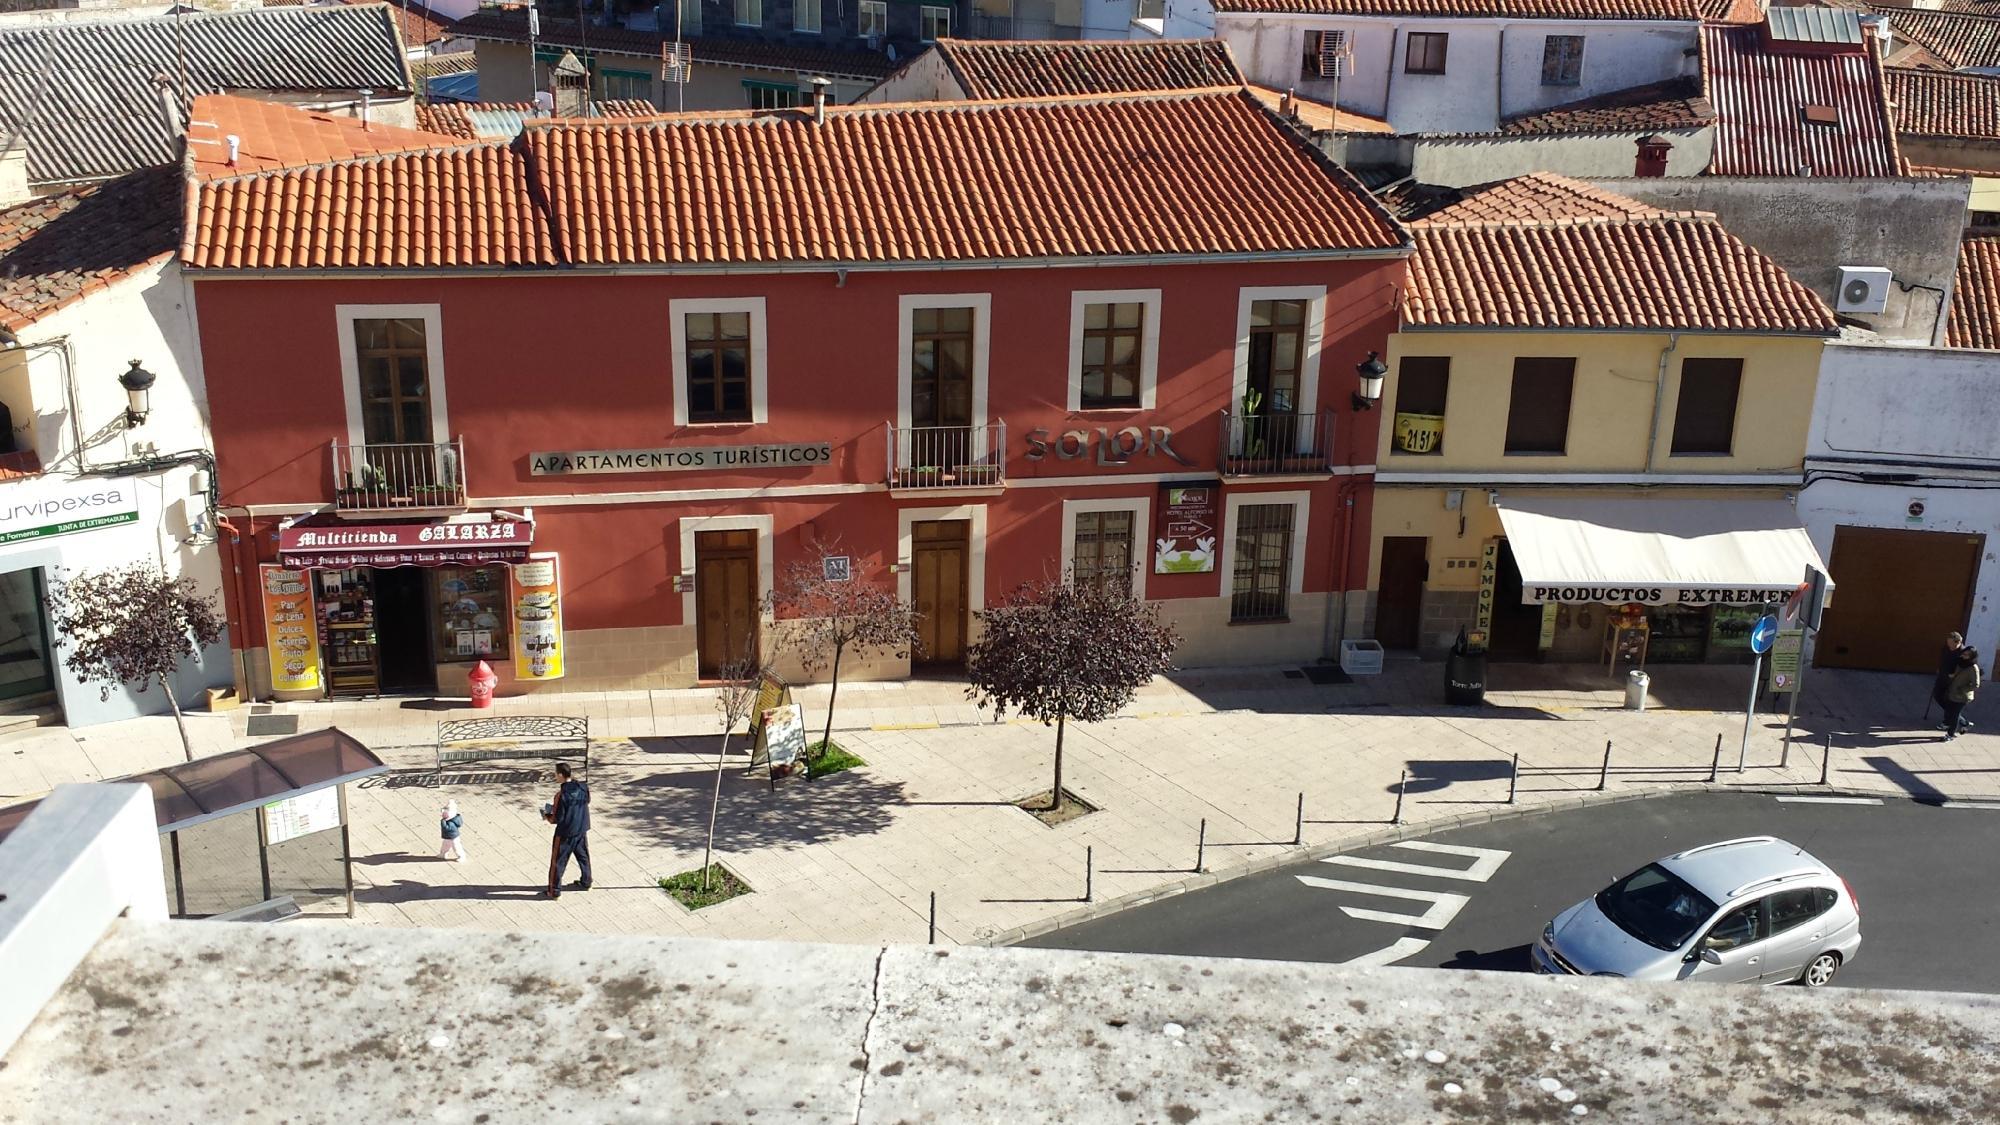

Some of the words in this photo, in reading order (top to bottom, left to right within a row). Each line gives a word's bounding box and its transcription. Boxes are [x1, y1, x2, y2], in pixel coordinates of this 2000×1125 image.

[532, 452, 705, 471] APARTAMENTOS
[713, 446, 831, 465] TURÍSTICOS
[58, 524, 79, 532] JUNTA
[87, 515, 131, 527] EXTREMADURA
[6, 530, 40, 540] Fomento
[297, 530, 398, 546] Multitienda
[418, 523, 516, 542] GALARZA
[1534, 587, 1662, 601] PRODUCTOS
[280, 601, 296, 610] Pan
[275, 613, 284, 621] de
[278, 625, 304, 633] Dulces
[277, 637, 307, 646] Caseros
[281, 650, 305, 658] Frutos
[284, 662, 305, 670] Secos
